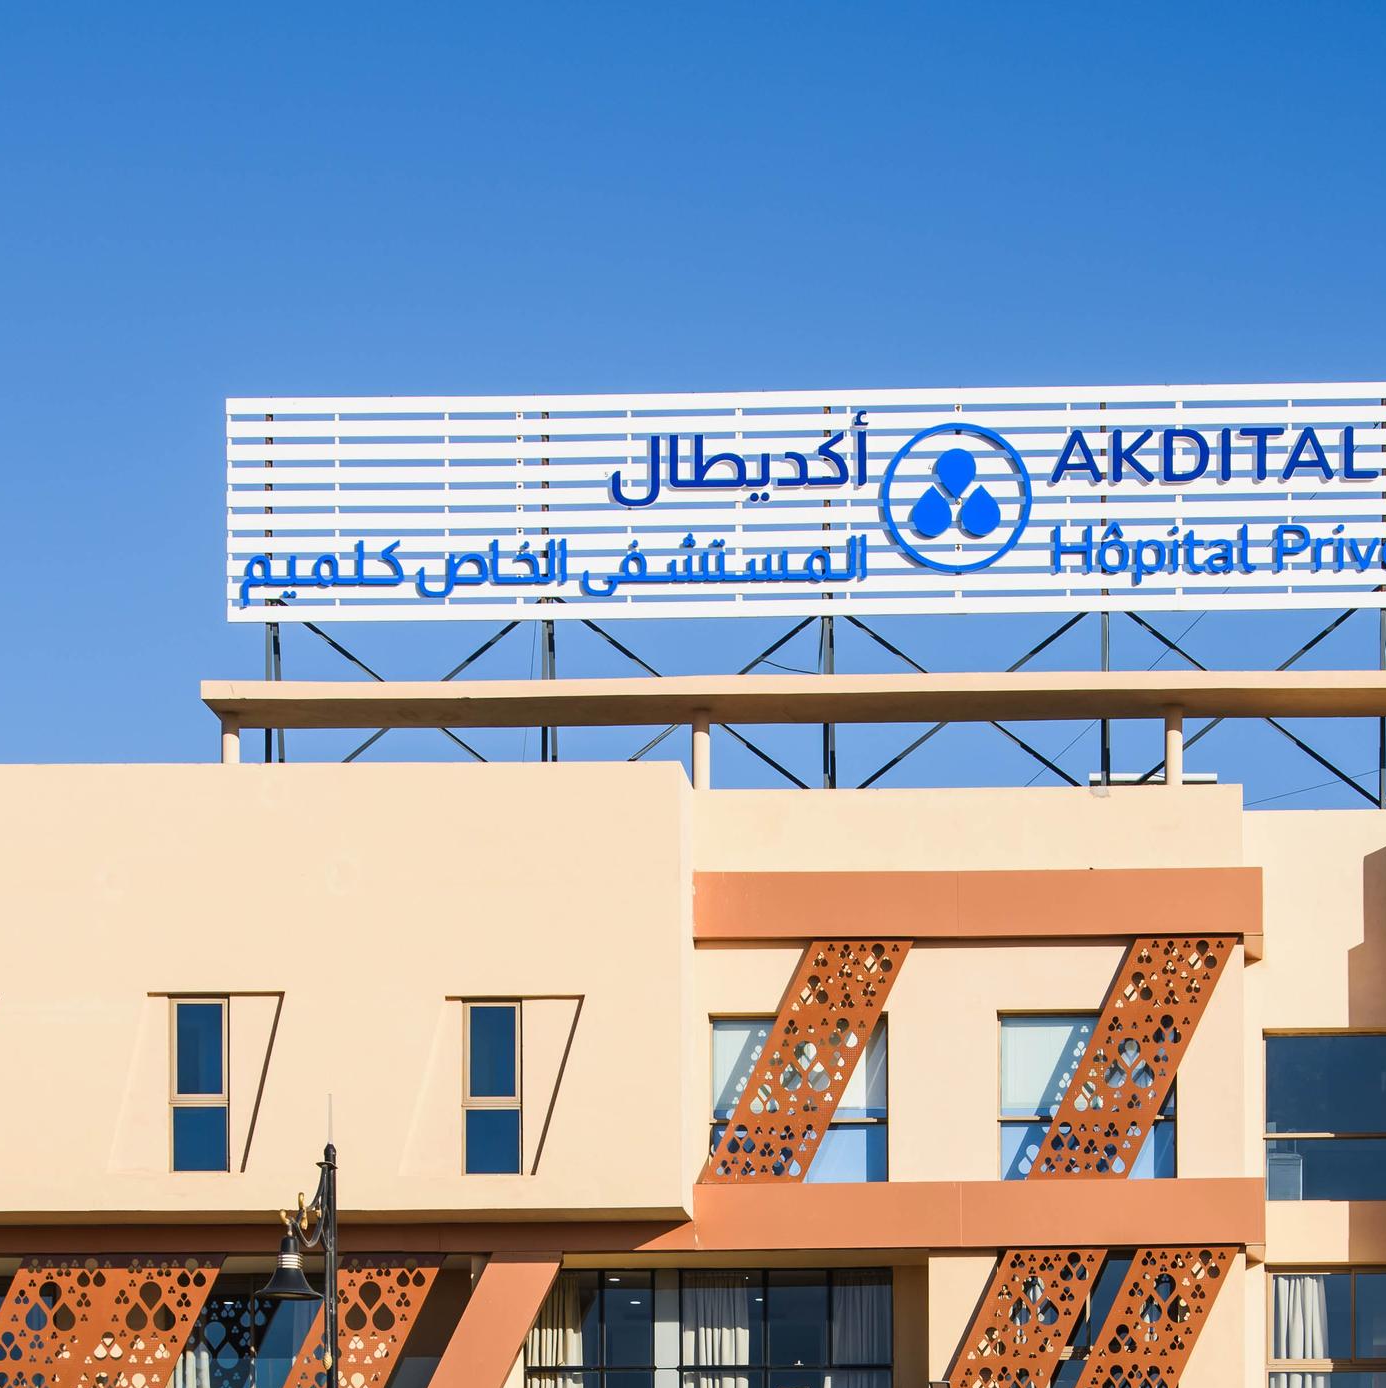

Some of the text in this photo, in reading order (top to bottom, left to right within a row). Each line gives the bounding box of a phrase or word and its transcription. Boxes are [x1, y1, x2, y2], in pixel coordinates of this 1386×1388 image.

[610, 410, 869, 507] أكديطال
[1051, 425, 1380, 484] AKDITAL
[239, 532, 867, 609] المستشفى الخاص كلميم
[1051, 520, 1256, 586] Hôpital
